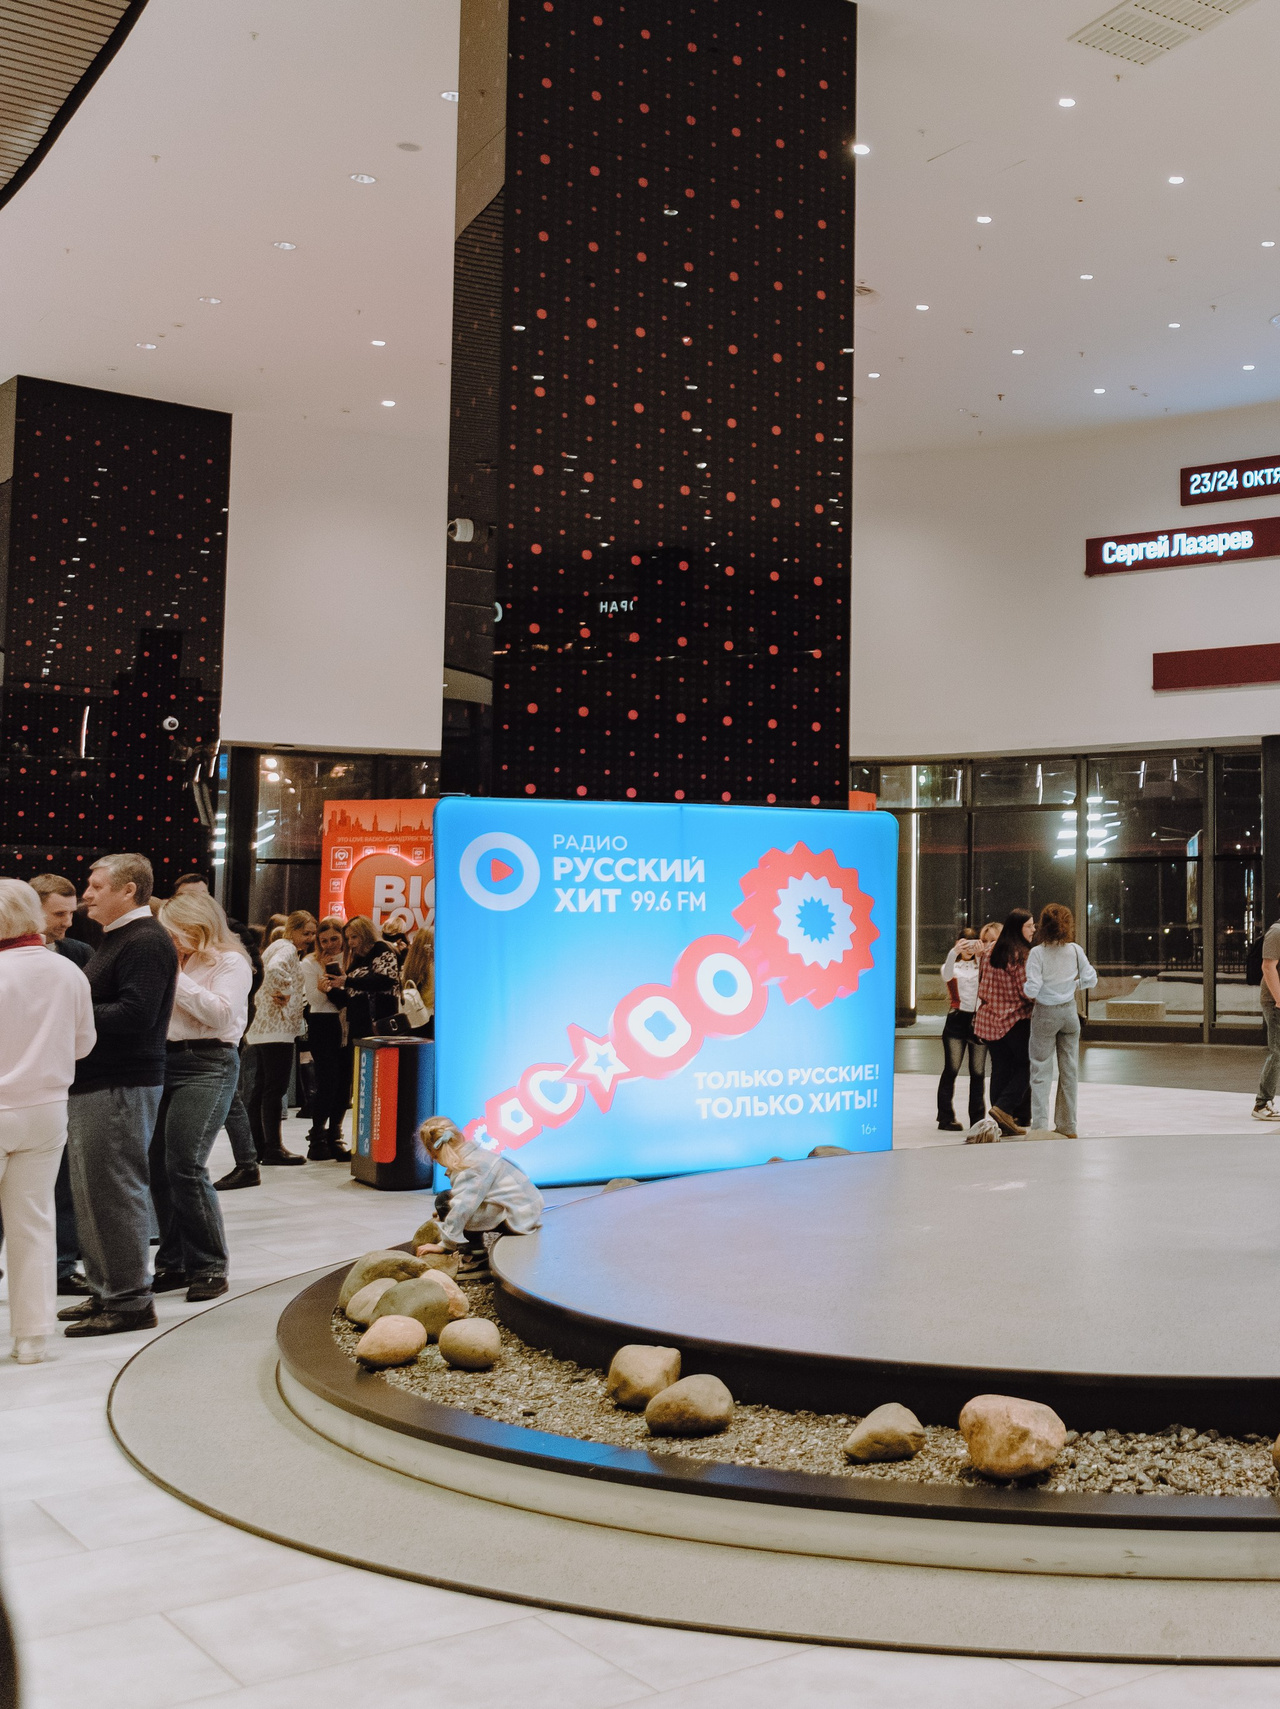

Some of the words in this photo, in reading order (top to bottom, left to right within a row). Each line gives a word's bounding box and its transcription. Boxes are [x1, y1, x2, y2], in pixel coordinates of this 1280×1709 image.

[1190, 468, 1239, 495] 23/24
[1102, 534, 1170, 566] Сергей
[1171, 530, 1254, 558] Лазарев
[553, 834, 628, 853] РАДИО
[553, 856, 705, 883] РУССКИЙ
[554, 888, 622, 913] ХИТ
[631, 890, 672, 912] 99.6
[677, 891, 706, 912] FM
[694, 1069, 784, 1090] ТОЛЬКО
[788, 1064, 880, 1086] РУССКИЕ!
[359, 1052, 367, 1136] СТЕКЛО
[696, 1093, 804, 1119] ТОЛЬКО
[809, 1088, 878, 1114] ХИТЫ!
[861, 1123, 877, 1135] 16+
